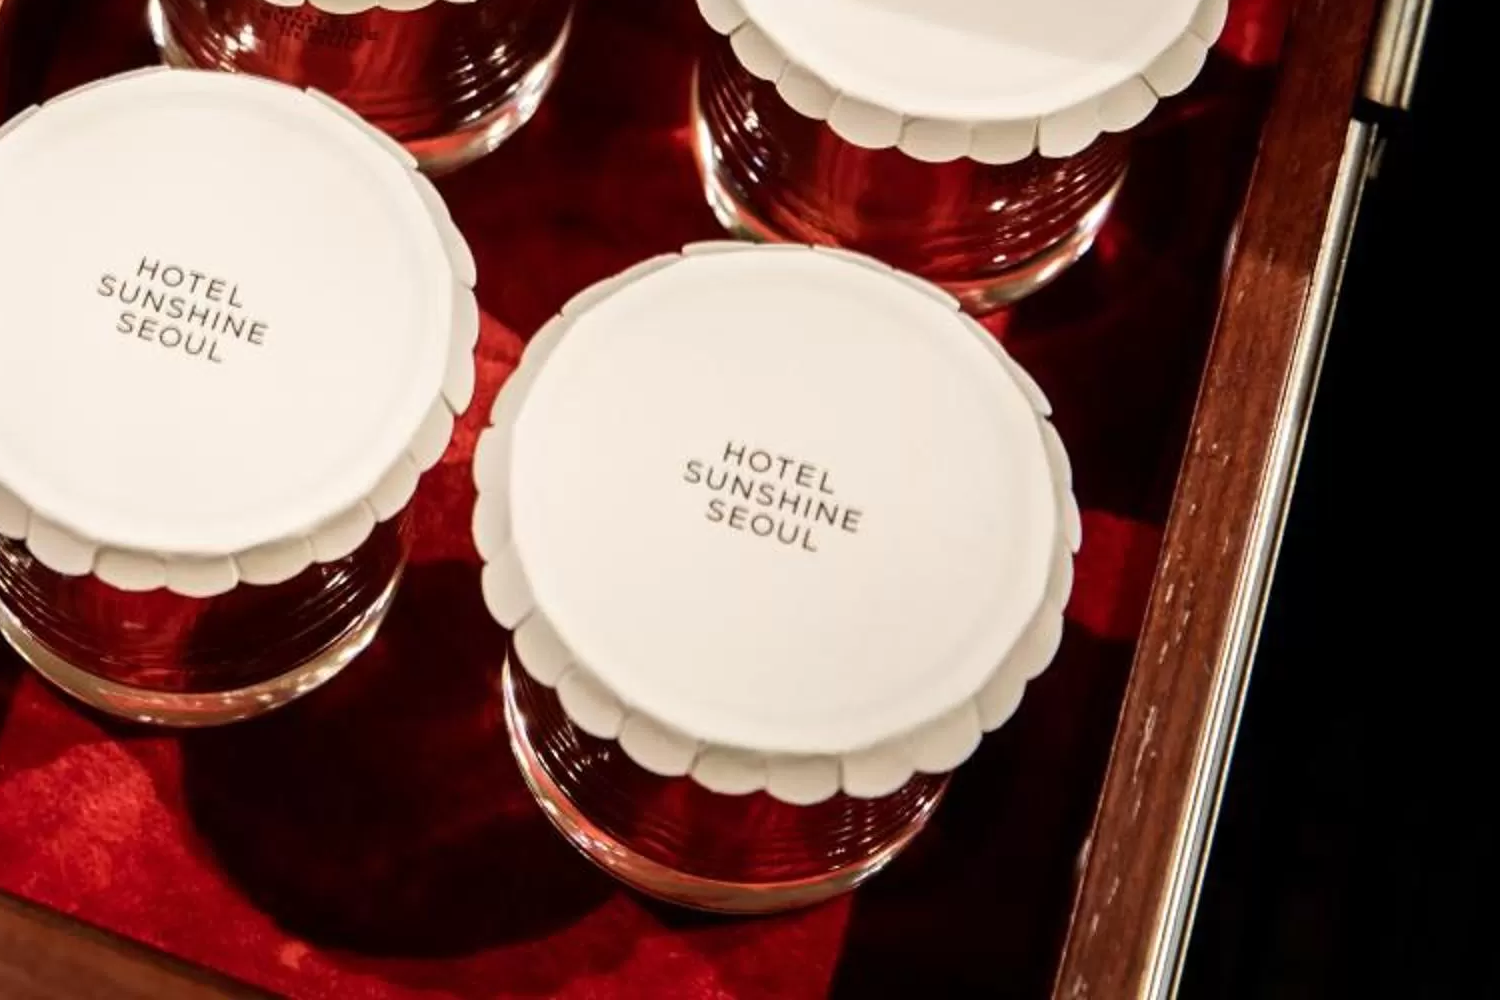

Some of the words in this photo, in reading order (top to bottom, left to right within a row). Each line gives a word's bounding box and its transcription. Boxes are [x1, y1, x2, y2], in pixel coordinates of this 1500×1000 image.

[136, 255, 243, 309] HOTEL
[97, 274, 269, 345] SUNSHINE
[115, 311, 222, 363] SEOUL
[723, 441, 835, 495] HOTEL
[683, 459, 863, 533] SUNSHINE
[705, 499, 818, 553] SEOUL
